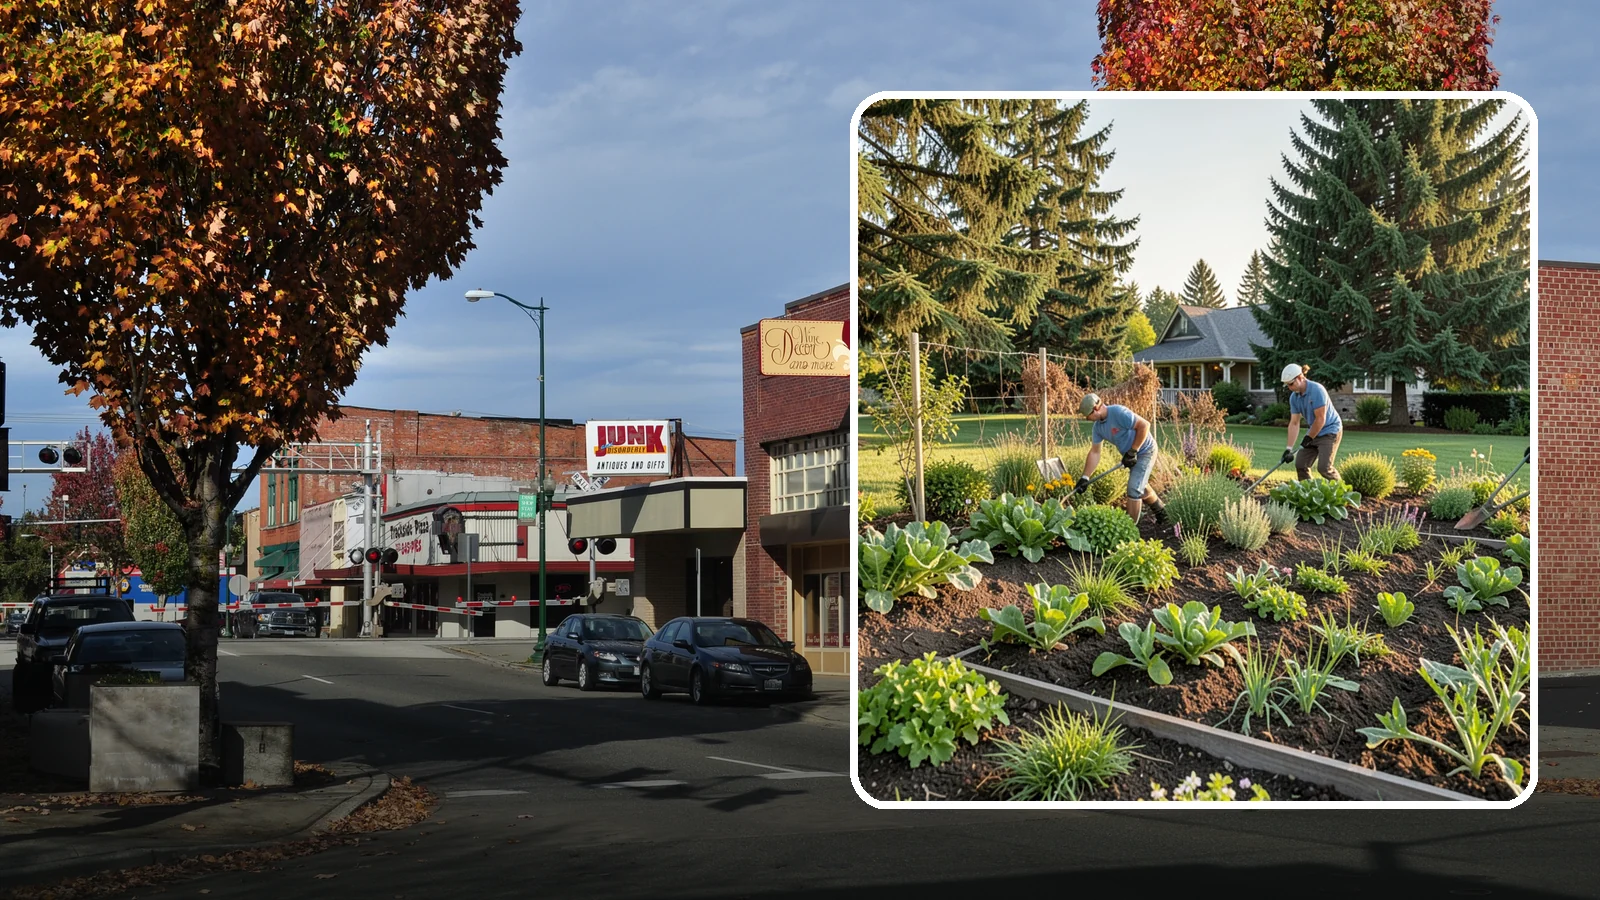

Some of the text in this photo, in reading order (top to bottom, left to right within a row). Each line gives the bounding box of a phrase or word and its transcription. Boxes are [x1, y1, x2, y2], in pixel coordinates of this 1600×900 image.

[595, 425, 666, 457] JUNK
[607, 446, 646, 454] DISORDERLY
[597, 460, 665, 470] ANTIQUES AND GIFTS
[390, 519, 429, 539] Trackside Pizza
